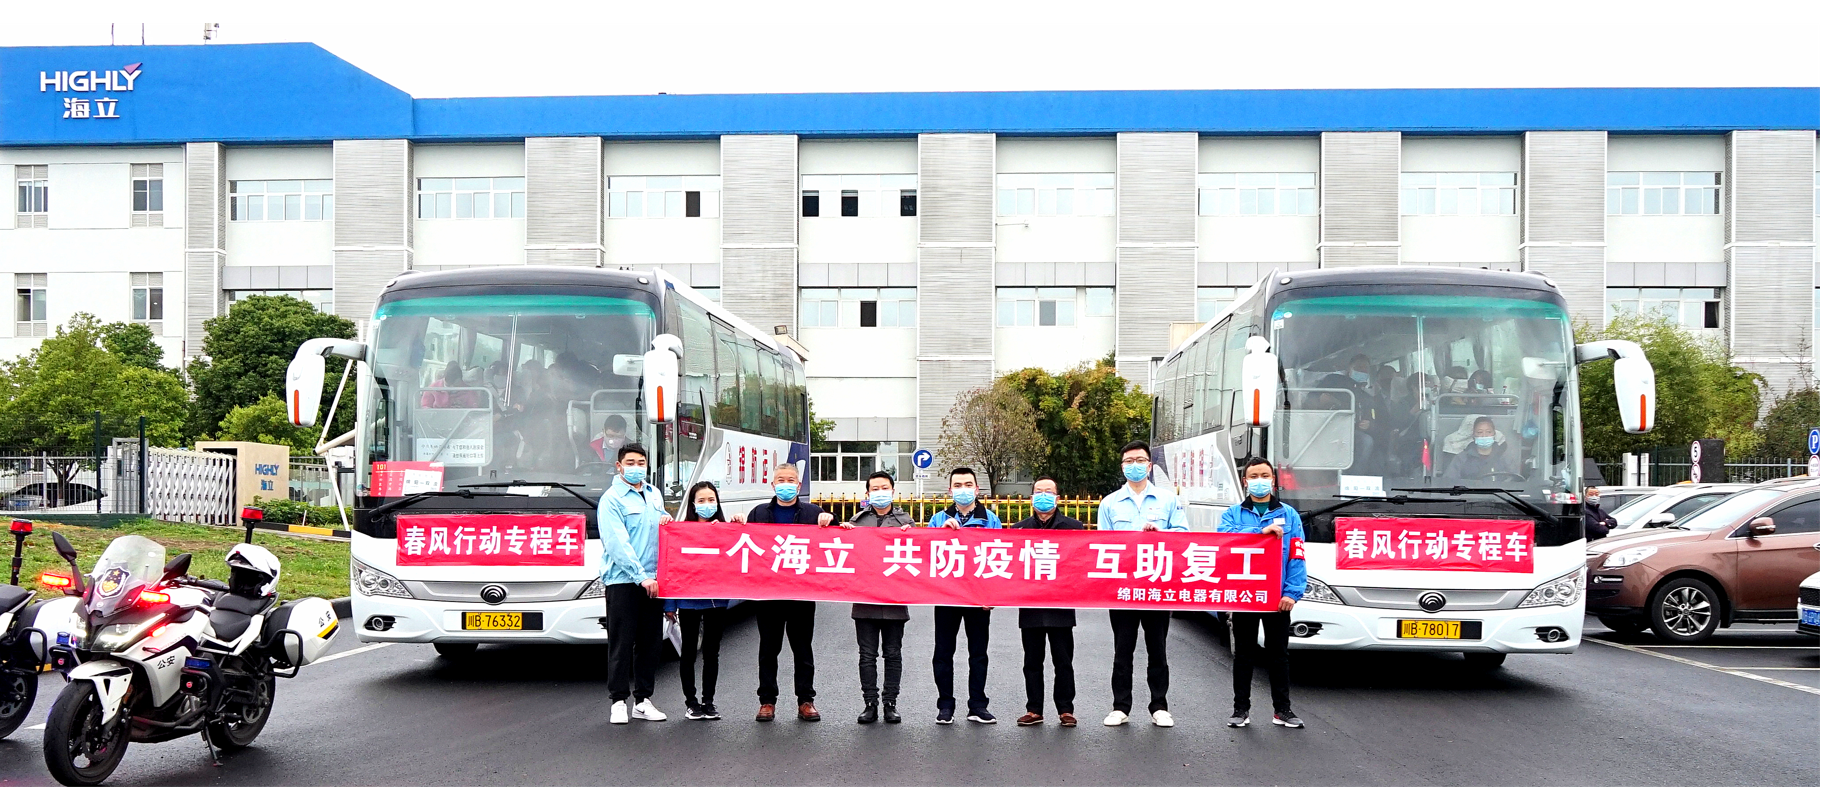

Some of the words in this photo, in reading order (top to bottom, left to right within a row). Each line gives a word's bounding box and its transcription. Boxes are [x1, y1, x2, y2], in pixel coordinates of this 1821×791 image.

[40, 69, 142, 92] HIGHLY
[63, 97, 120, 119] 海立
[1811, 434, 1819, 449] P
[1693, 446, 1699, 458] 5
[254, 463, 280, 476] HIGHLY
[404, 525, 579, 556] 春风行动专程车
[1344, 528, 1528, 562] 春风行动专程车
[681, 533, 855, 574] 一个海立
[883, 538, 1060, 581] 共防疫情
[1087, 542, 1267, 584] 互助复工
[1116, 587, 1268, 604] 绵阳海立电器有限公司
[157, 655, 176, 669] 公安
